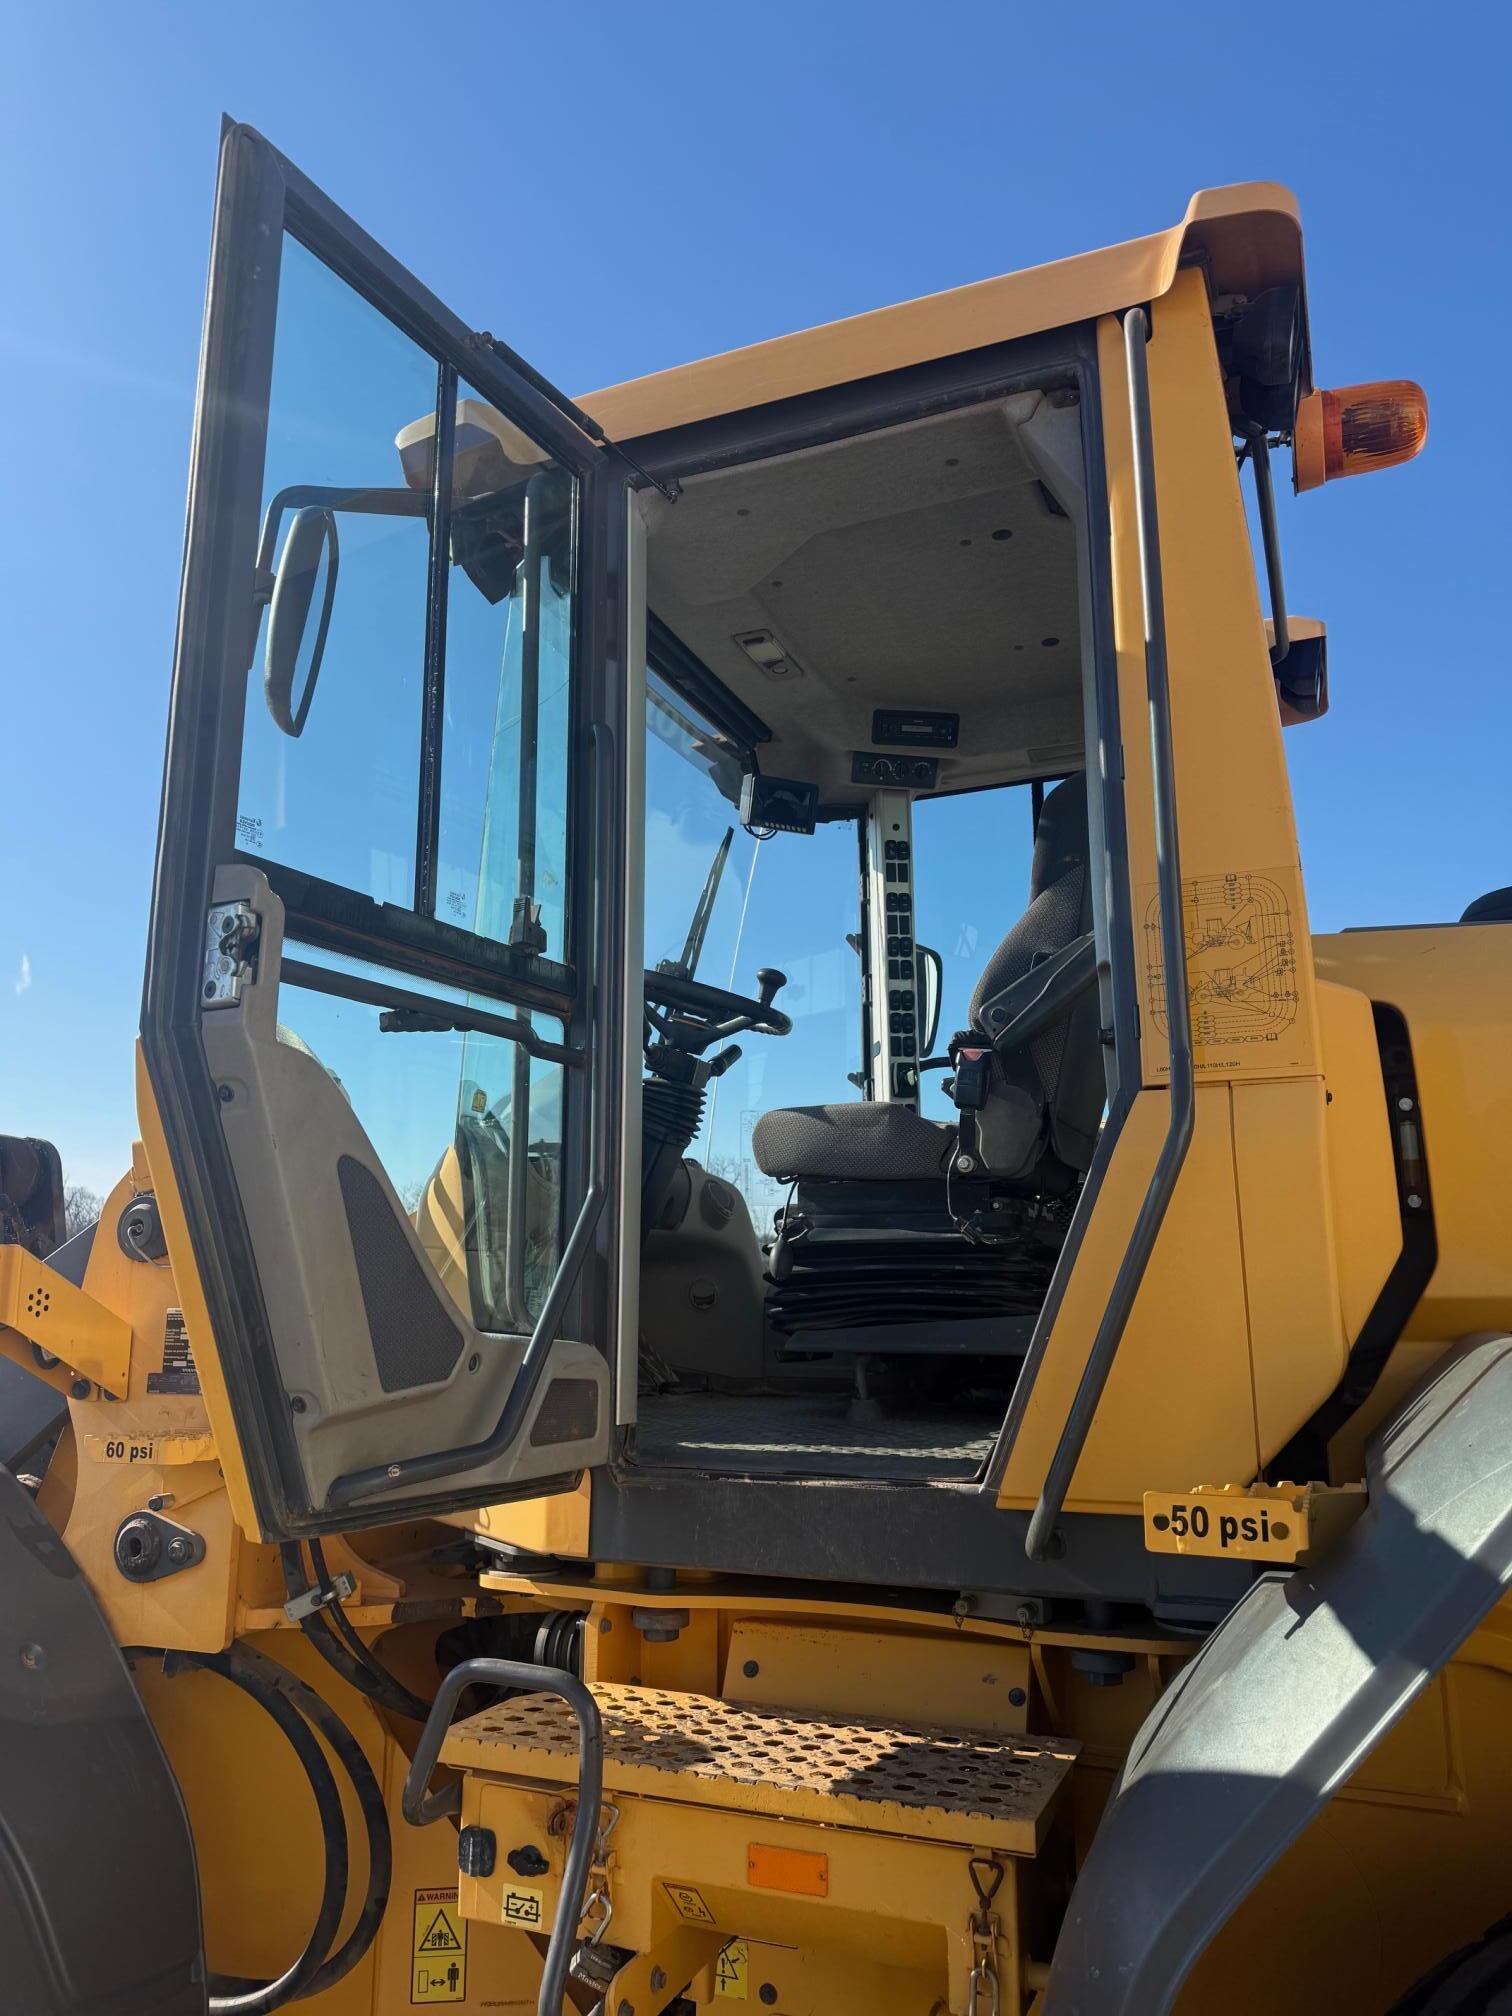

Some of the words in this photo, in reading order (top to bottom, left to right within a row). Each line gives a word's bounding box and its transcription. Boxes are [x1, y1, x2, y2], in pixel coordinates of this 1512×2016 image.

[106, 1441, 124, 1458] 60
[130, 1442, 153, 1462] psi
[1171, 1504, 1208, 1538] 50
[1219, 1510, 1269, 1548] psi
[426, 1892, 458, 1901] WARNIN
[577, 1972, 603, 1991] Master
